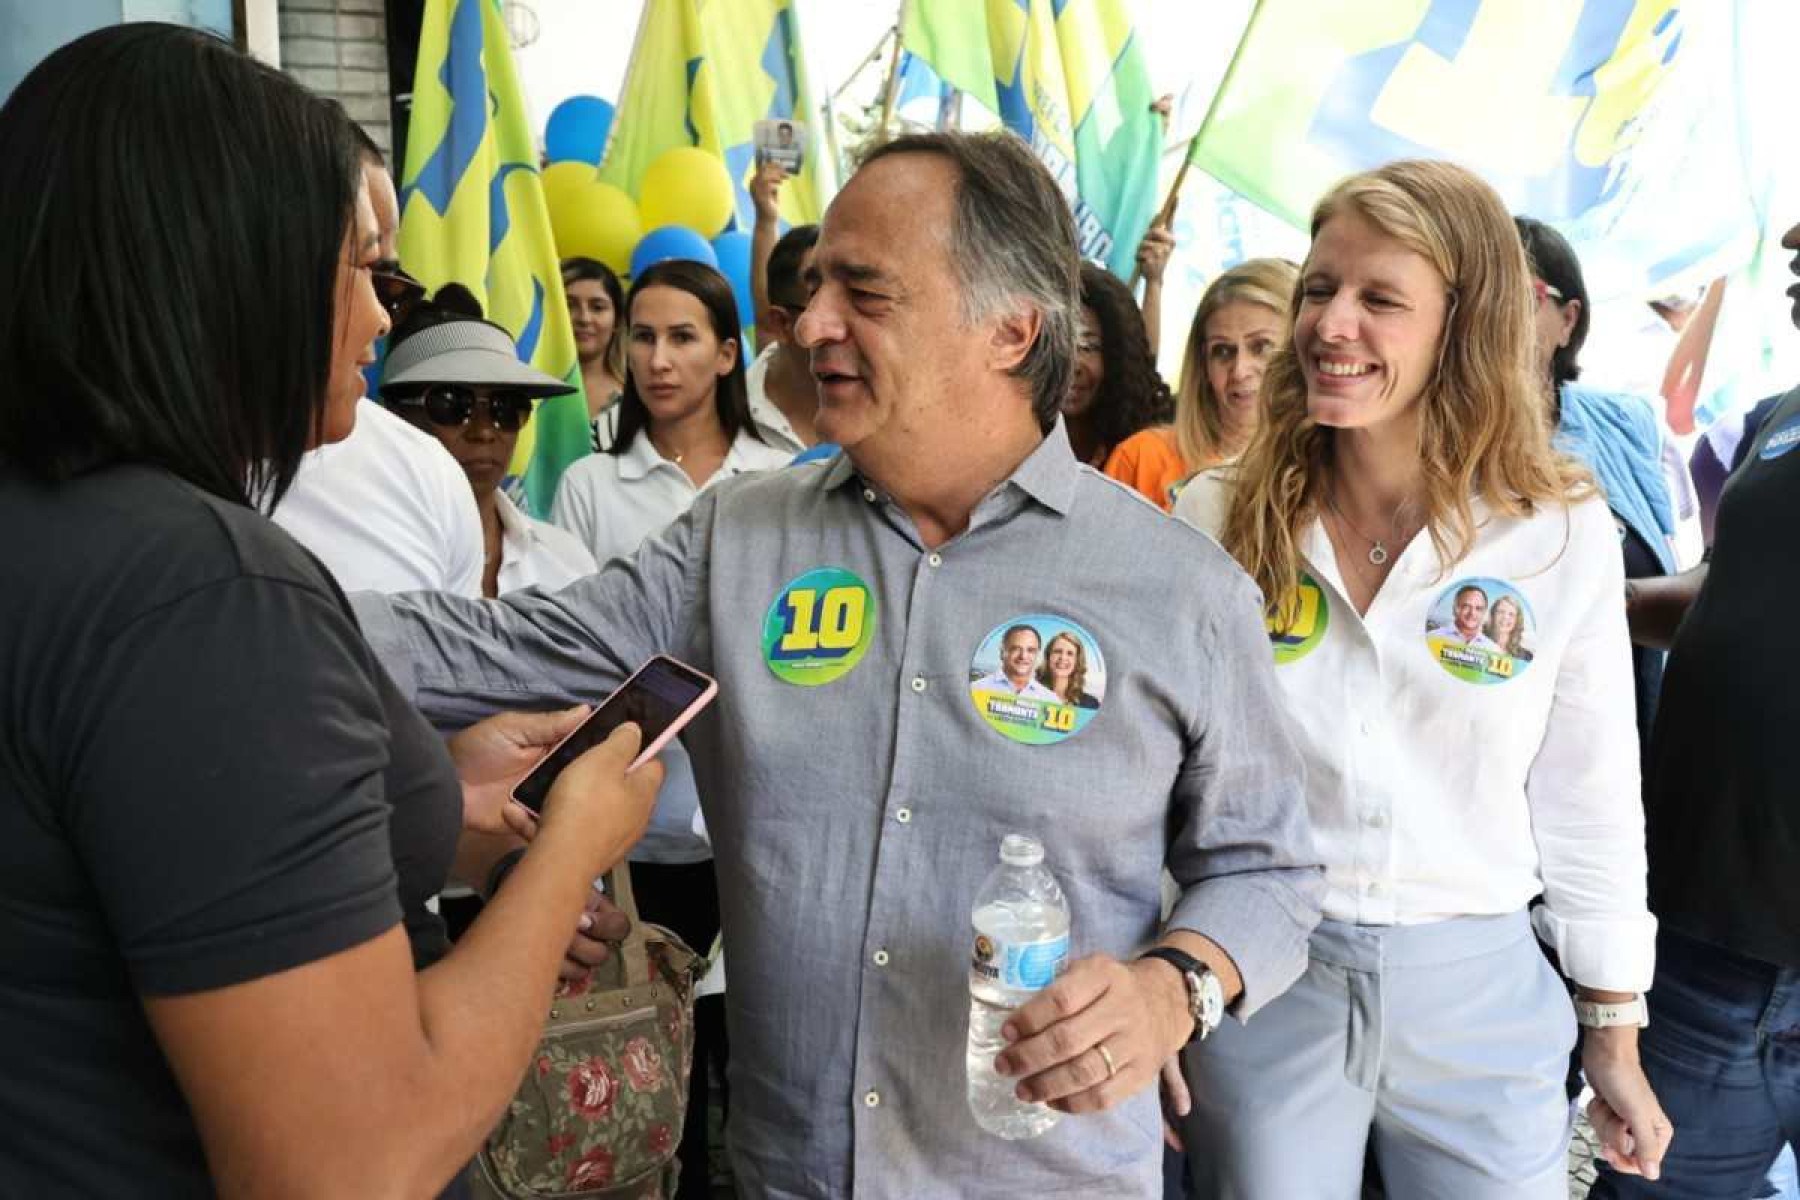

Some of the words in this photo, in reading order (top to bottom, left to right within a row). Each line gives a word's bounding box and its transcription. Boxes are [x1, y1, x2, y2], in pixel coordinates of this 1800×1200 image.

[781, 586, 866, 651] 10
[1487, 654, 1513, 677] 10
[1043, 705, 1075, 731] 10
